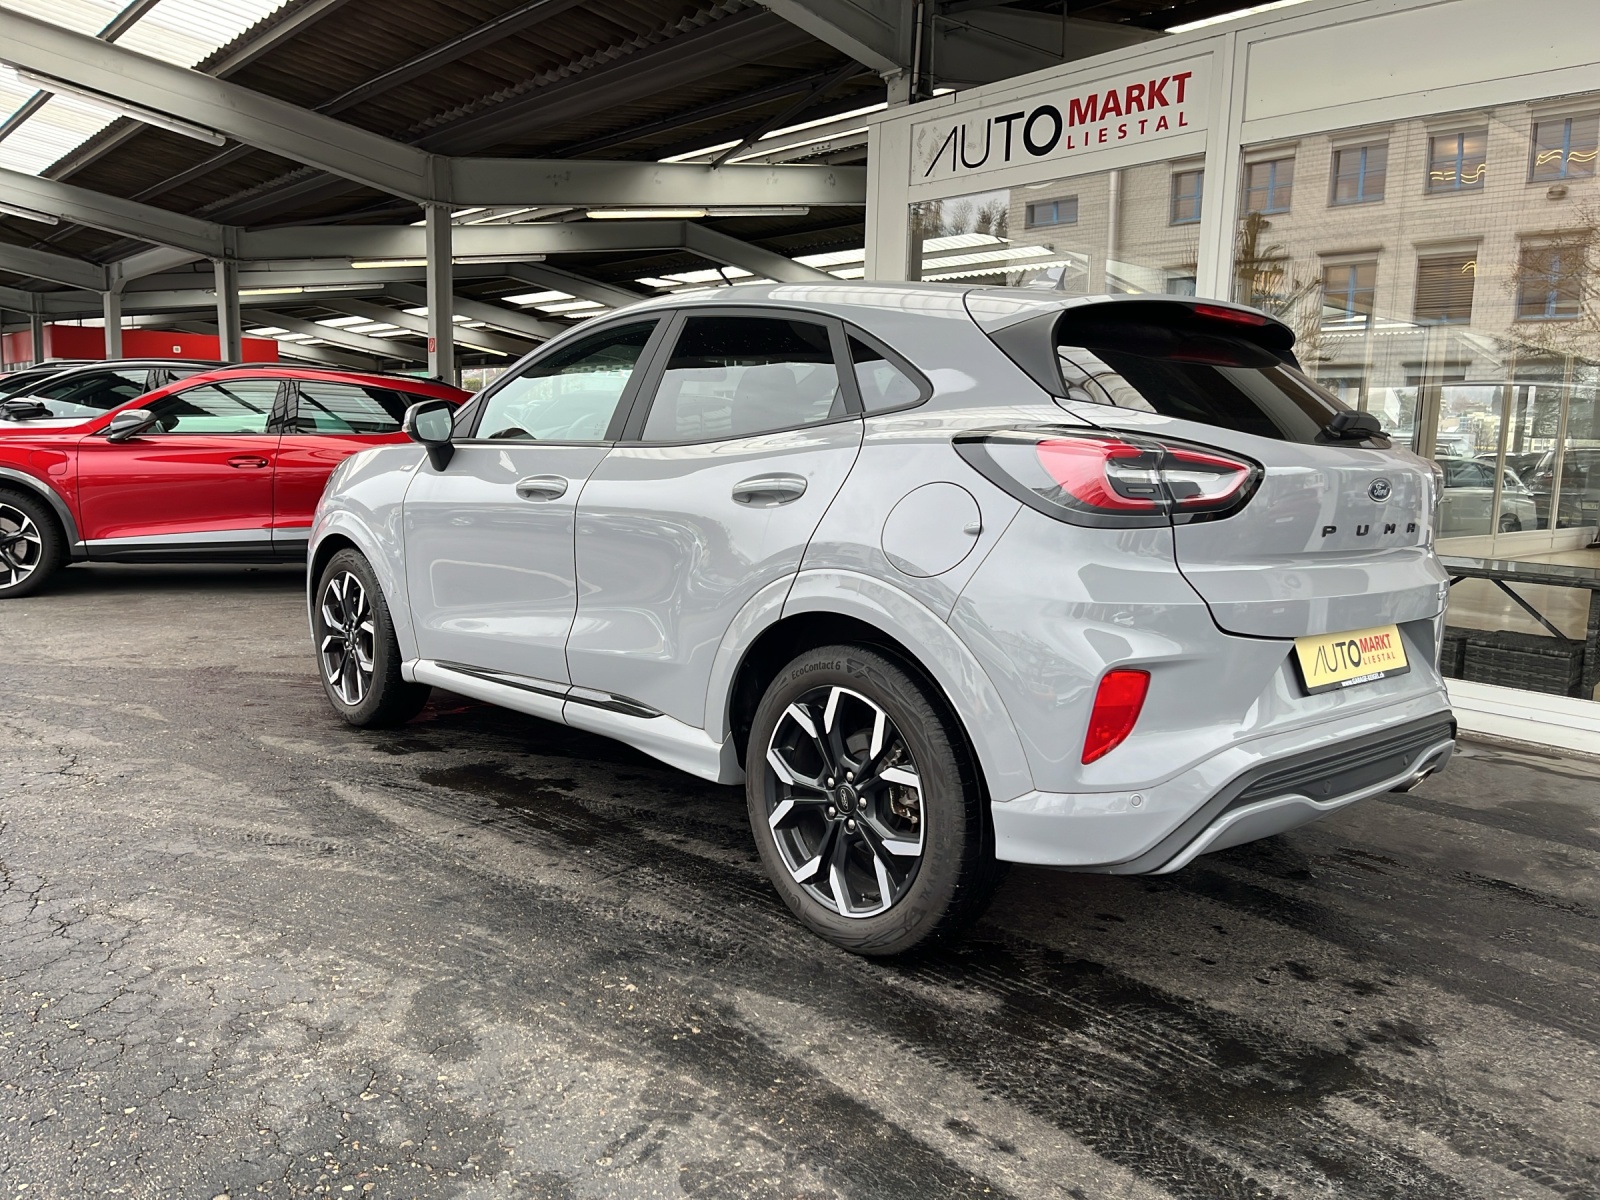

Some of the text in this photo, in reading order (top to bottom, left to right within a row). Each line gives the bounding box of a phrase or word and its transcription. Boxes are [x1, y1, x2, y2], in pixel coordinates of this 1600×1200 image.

[924, 71, 1193, 177] AUTO MARKT
[1066, 111, 1189, 150] LIESTAL
[1373, 482, 1390, 496] Ford
[1321, 522, 1416, 538] PUMA
[1313, 633, 1392, 677] AUTO MARKT
[1362, 651, 1396, 666] LIESTAL
[791, 660, 842, 680] EcoContact 6
